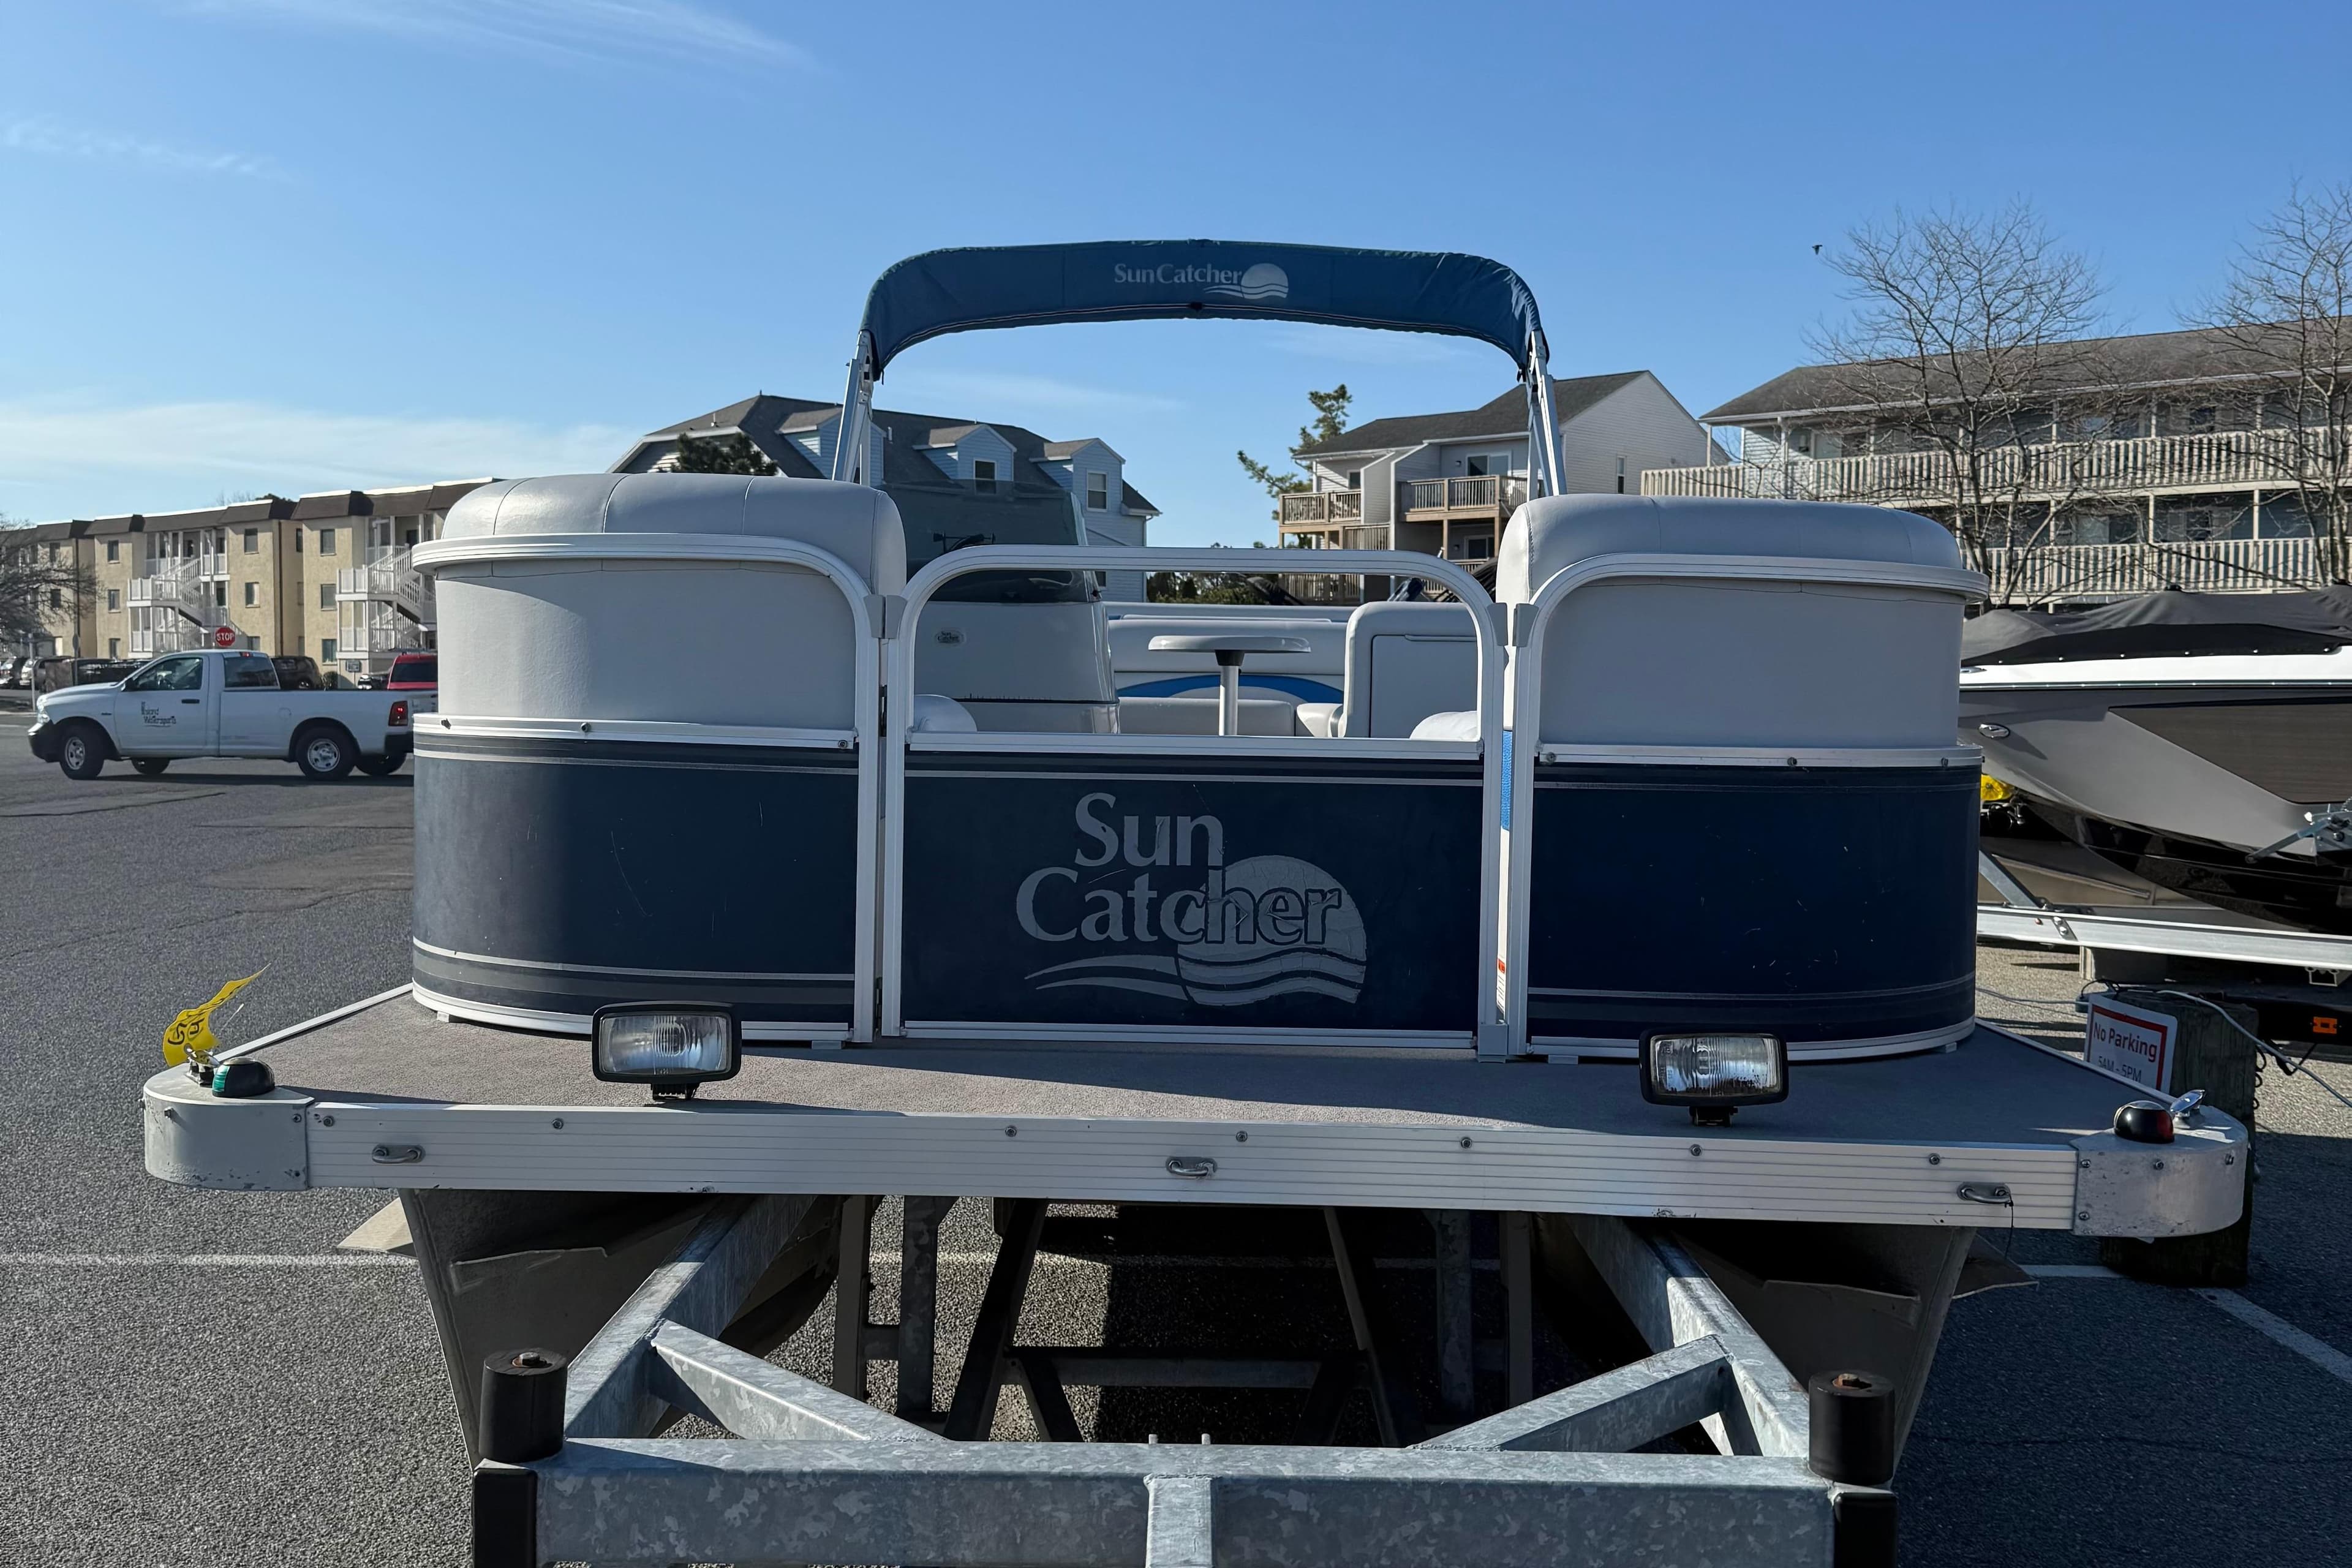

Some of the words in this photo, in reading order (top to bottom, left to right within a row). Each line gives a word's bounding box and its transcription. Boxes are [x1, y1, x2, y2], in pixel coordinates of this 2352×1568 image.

[217, 632, 235, 641] STOP
[1074, 792, 1224, 867] Sun
[1016, 867, 1342, 946] Catcher
[2093, 1022, 2106, 1041] No
[2108, 1027, 2158, 1063] Parking
[2122, 1065, 2142, 1083] 5PM
